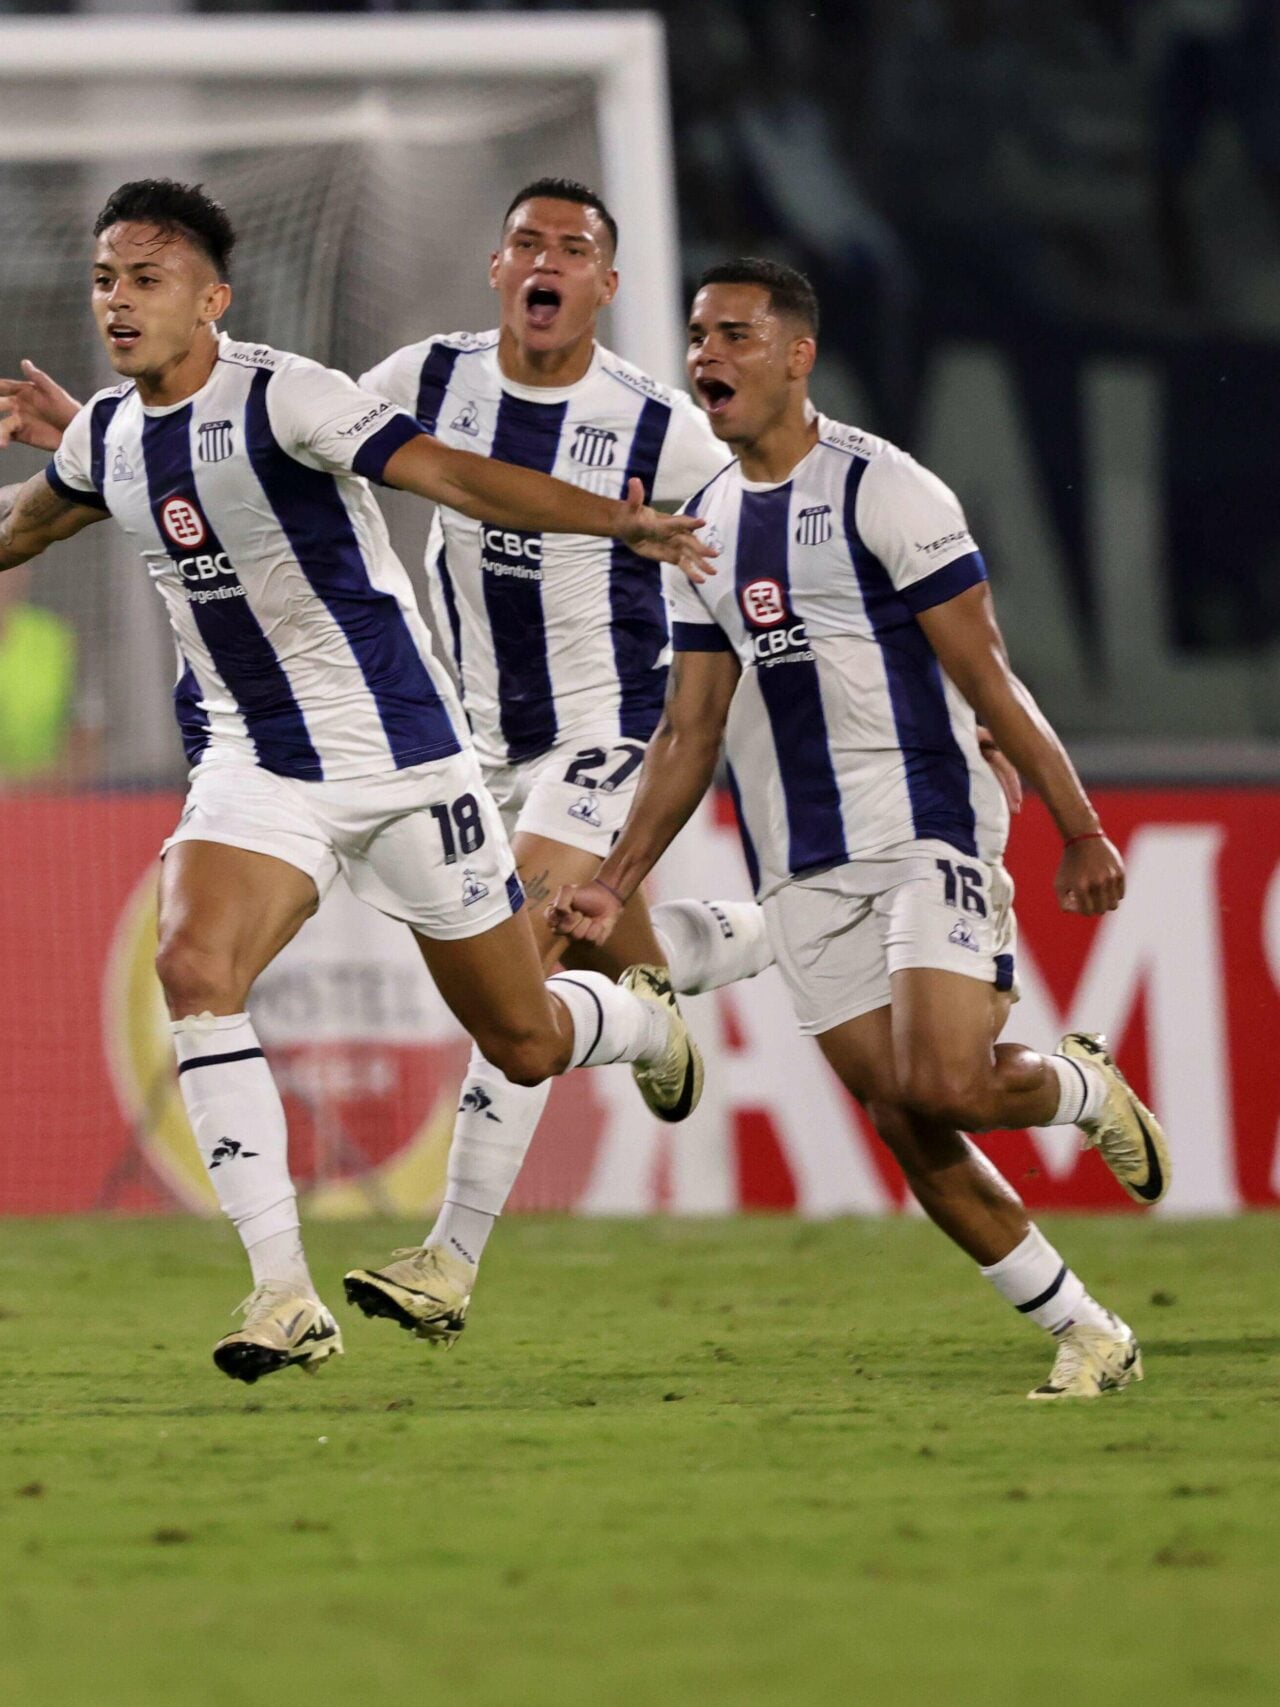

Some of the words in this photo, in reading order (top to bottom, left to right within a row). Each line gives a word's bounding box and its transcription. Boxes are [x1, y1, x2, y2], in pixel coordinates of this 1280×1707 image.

[346, 402, 393, 436] TERRA
[479, 527, 543, 560] ICBC
[481, 557, 544, 580] Argentina
[562, 743, 646, 792] 27
[430, 793, 485, 866] 18
[935, 858, 988, 919] 16
